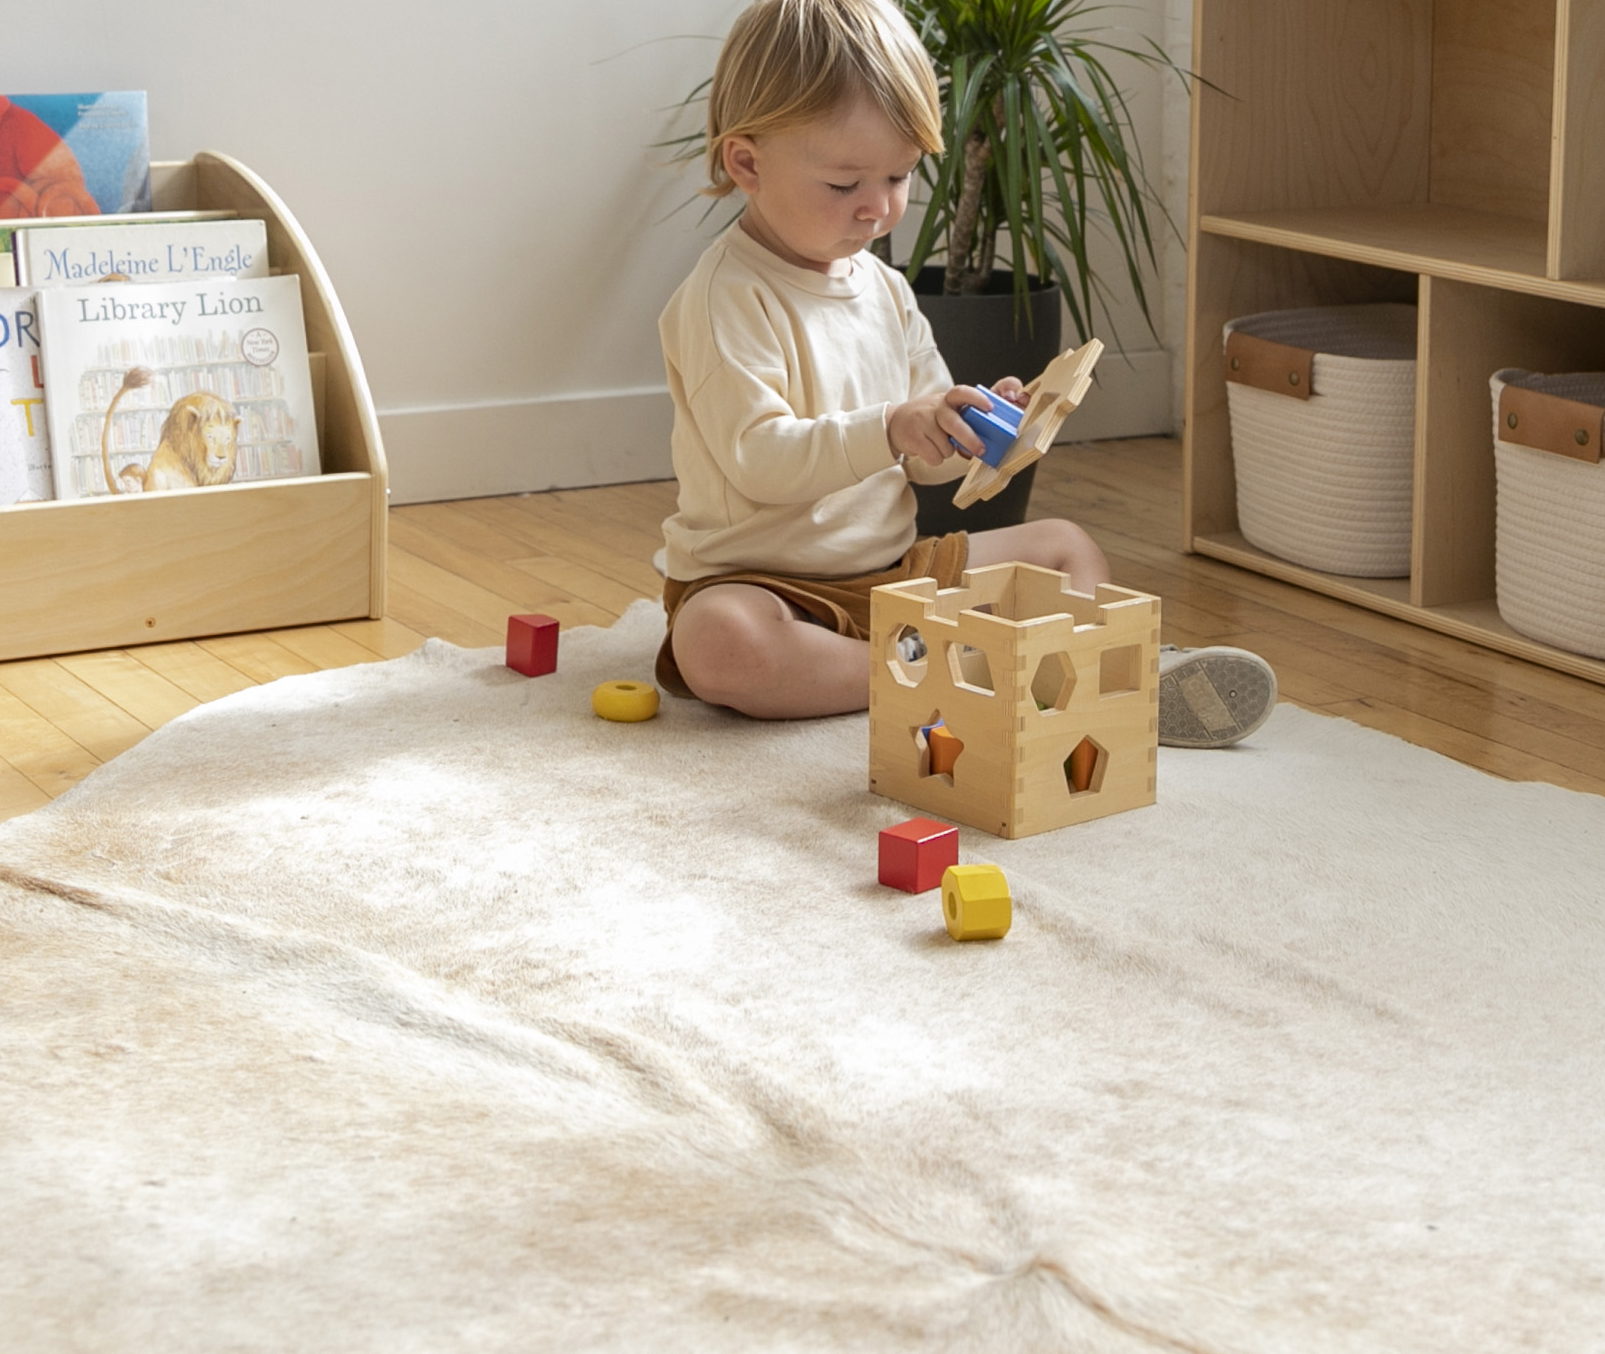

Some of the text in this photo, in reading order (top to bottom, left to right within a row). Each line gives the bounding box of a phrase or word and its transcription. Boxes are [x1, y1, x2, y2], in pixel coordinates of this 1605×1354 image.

[44, 247, 159, 281] Madeleine
[77, 291, 264, 326] Library Lion
